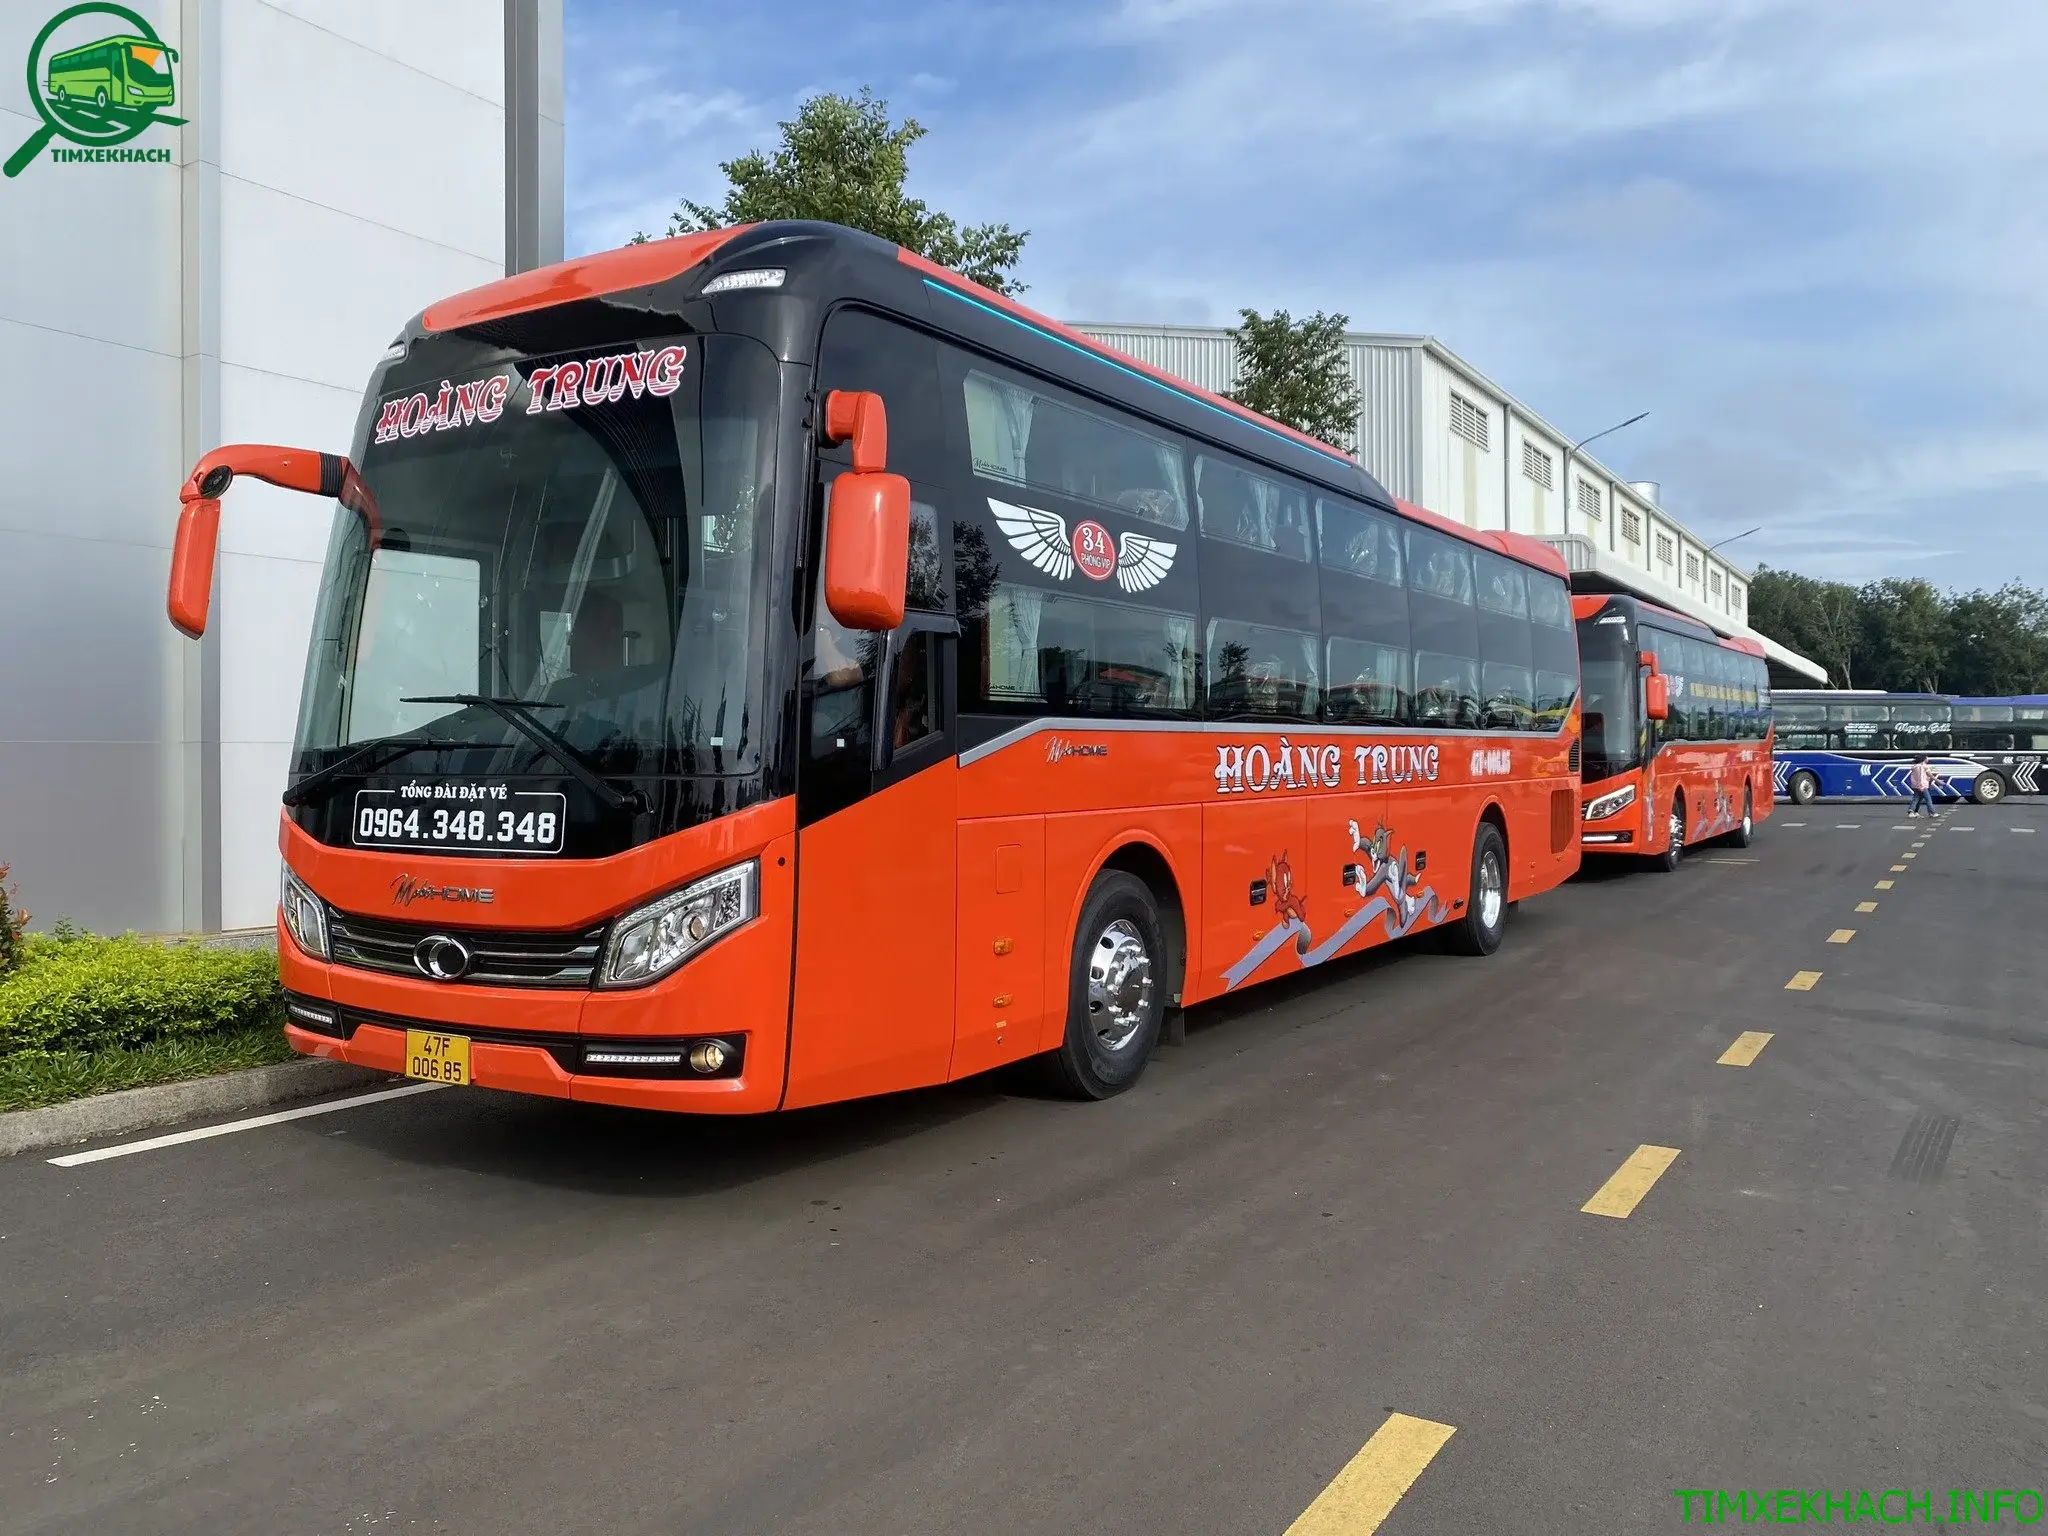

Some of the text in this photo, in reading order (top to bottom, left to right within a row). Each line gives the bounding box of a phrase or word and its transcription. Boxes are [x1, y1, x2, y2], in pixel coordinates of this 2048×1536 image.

[374, 346, 687, 444] HOÀNG TRUNG
[1082, 526, 1105, 554] 34
[1214, 735, 1439, 793] HOÀNG TRUNG
[401, 779, 508, 802] TỔNG ĐÀI ĐẶT VÉ
[359, 808, 556, 843] 0964.348.348
[424, 1036, 450, 1057] 47F
[413, 1056, 461, 1082] 006.85
